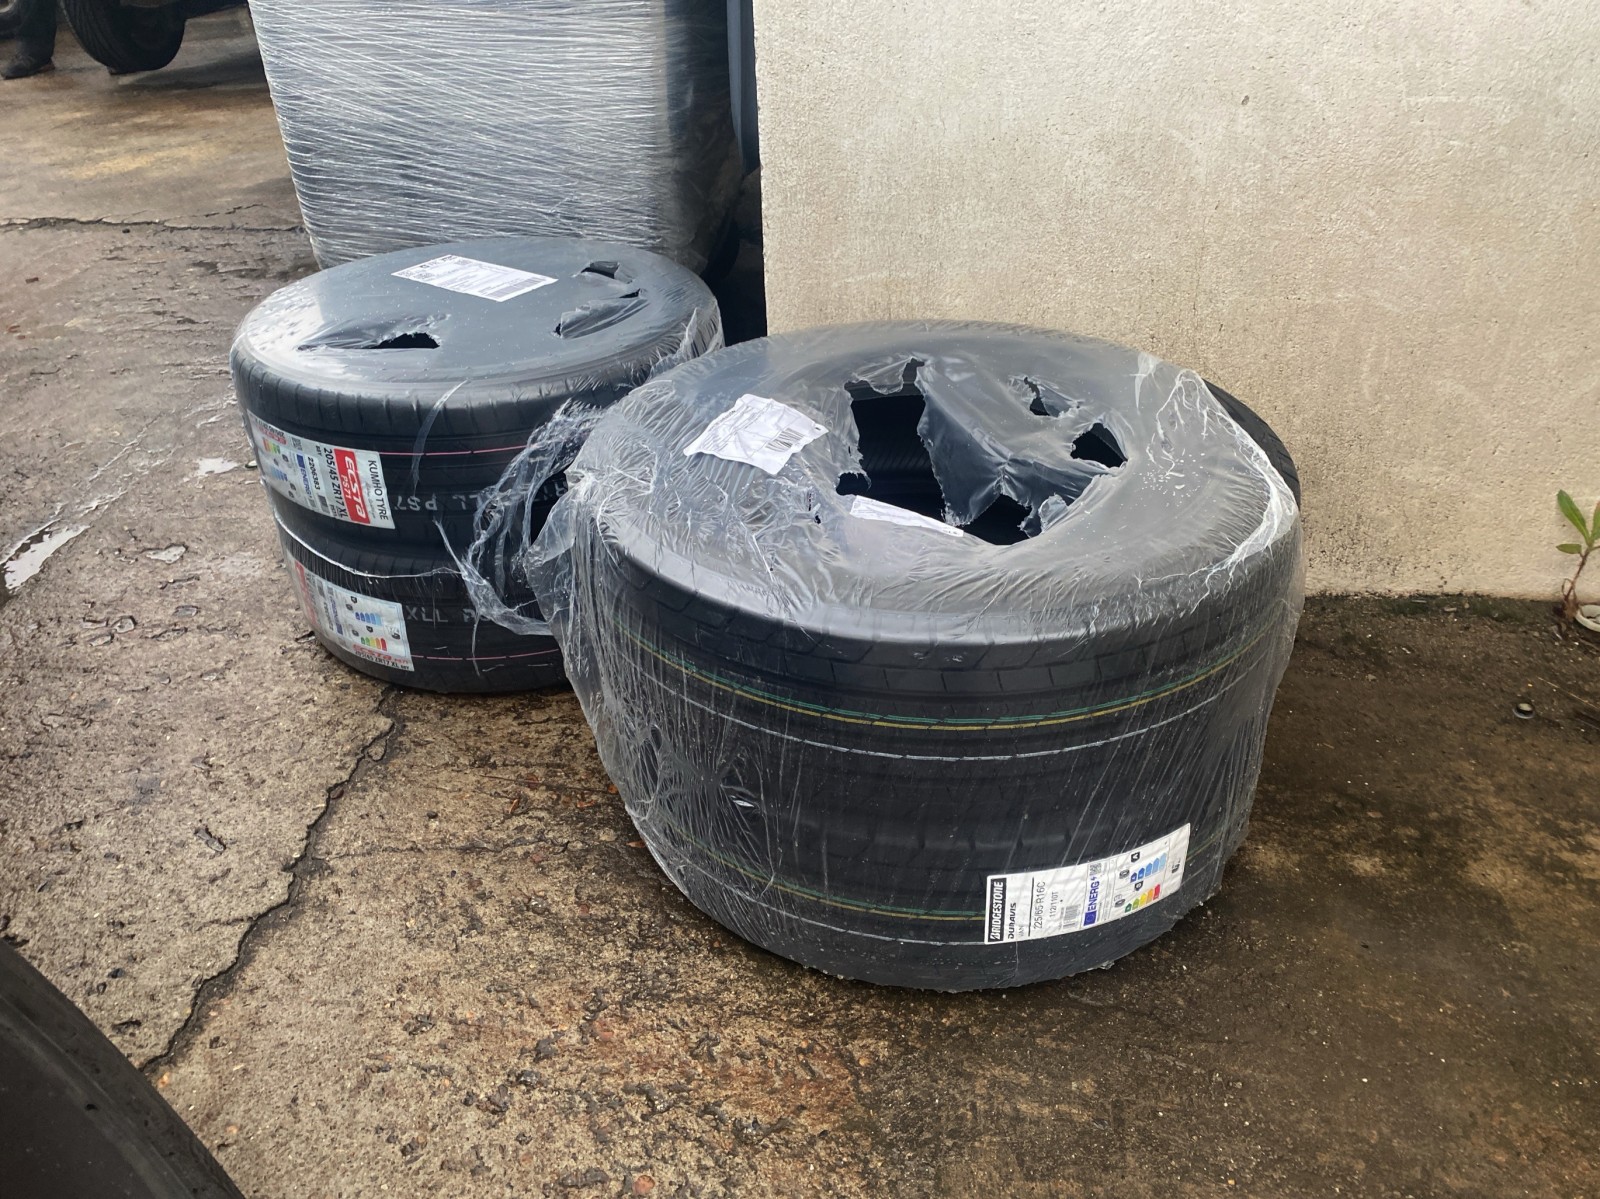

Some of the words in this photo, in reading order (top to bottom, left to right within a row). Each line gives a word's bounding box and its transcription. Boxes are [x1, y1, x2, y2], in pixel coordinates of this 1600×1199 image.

[308, 456, 320, 490] 2206383
[324, 447, 338, 482] 205/45
[332, 483, 344, 508] ZR17
[339, 508, 348, 518] XL
[340, 474, 352, 500] PS71
[368, 459, 382, 496] KUMHO
[376, 497, 388, 520] TYRE
[405, 606, 448, 622] XLL
[1036, 882, 1046, 904] R16C
[1088, 880, 1100, 912] ENERG
[990, 881, 1004, 940] BRIDGESTONE
[1008, 902, 1016, 940] DURAVIS
[1034, 904, 1044, 930] 225/65
